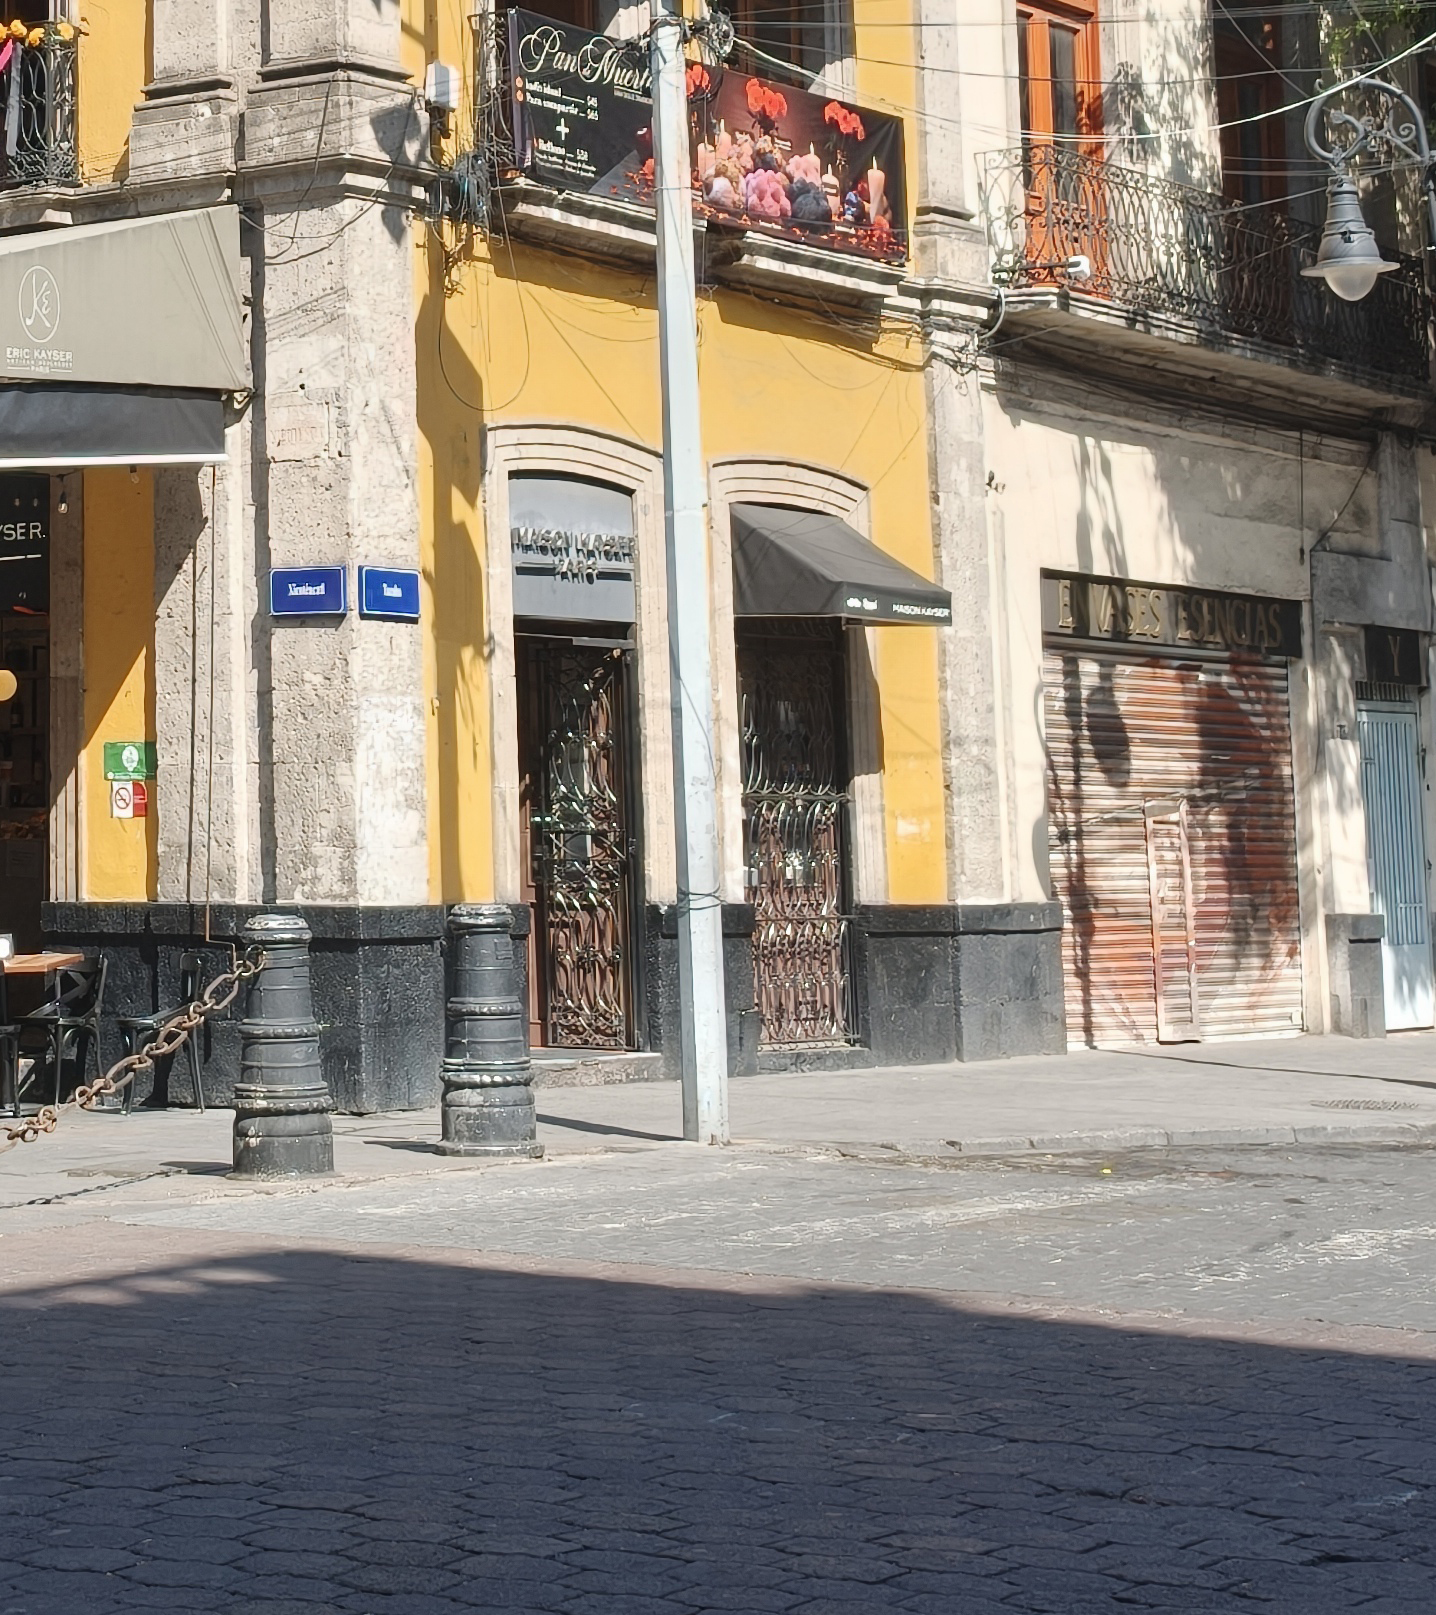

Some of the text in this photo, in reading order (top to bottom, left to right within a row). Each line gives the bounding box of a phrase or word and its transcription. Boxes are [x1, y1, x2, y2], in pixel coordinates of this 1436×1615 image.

[518, 25, 577, 73] Pan
[6, 347, 73, 362] ERIC KAYSER
[1058, 578, 1283, 649] ENVASES ESENCIAS
[1387, 635, 1401, 677] Y
